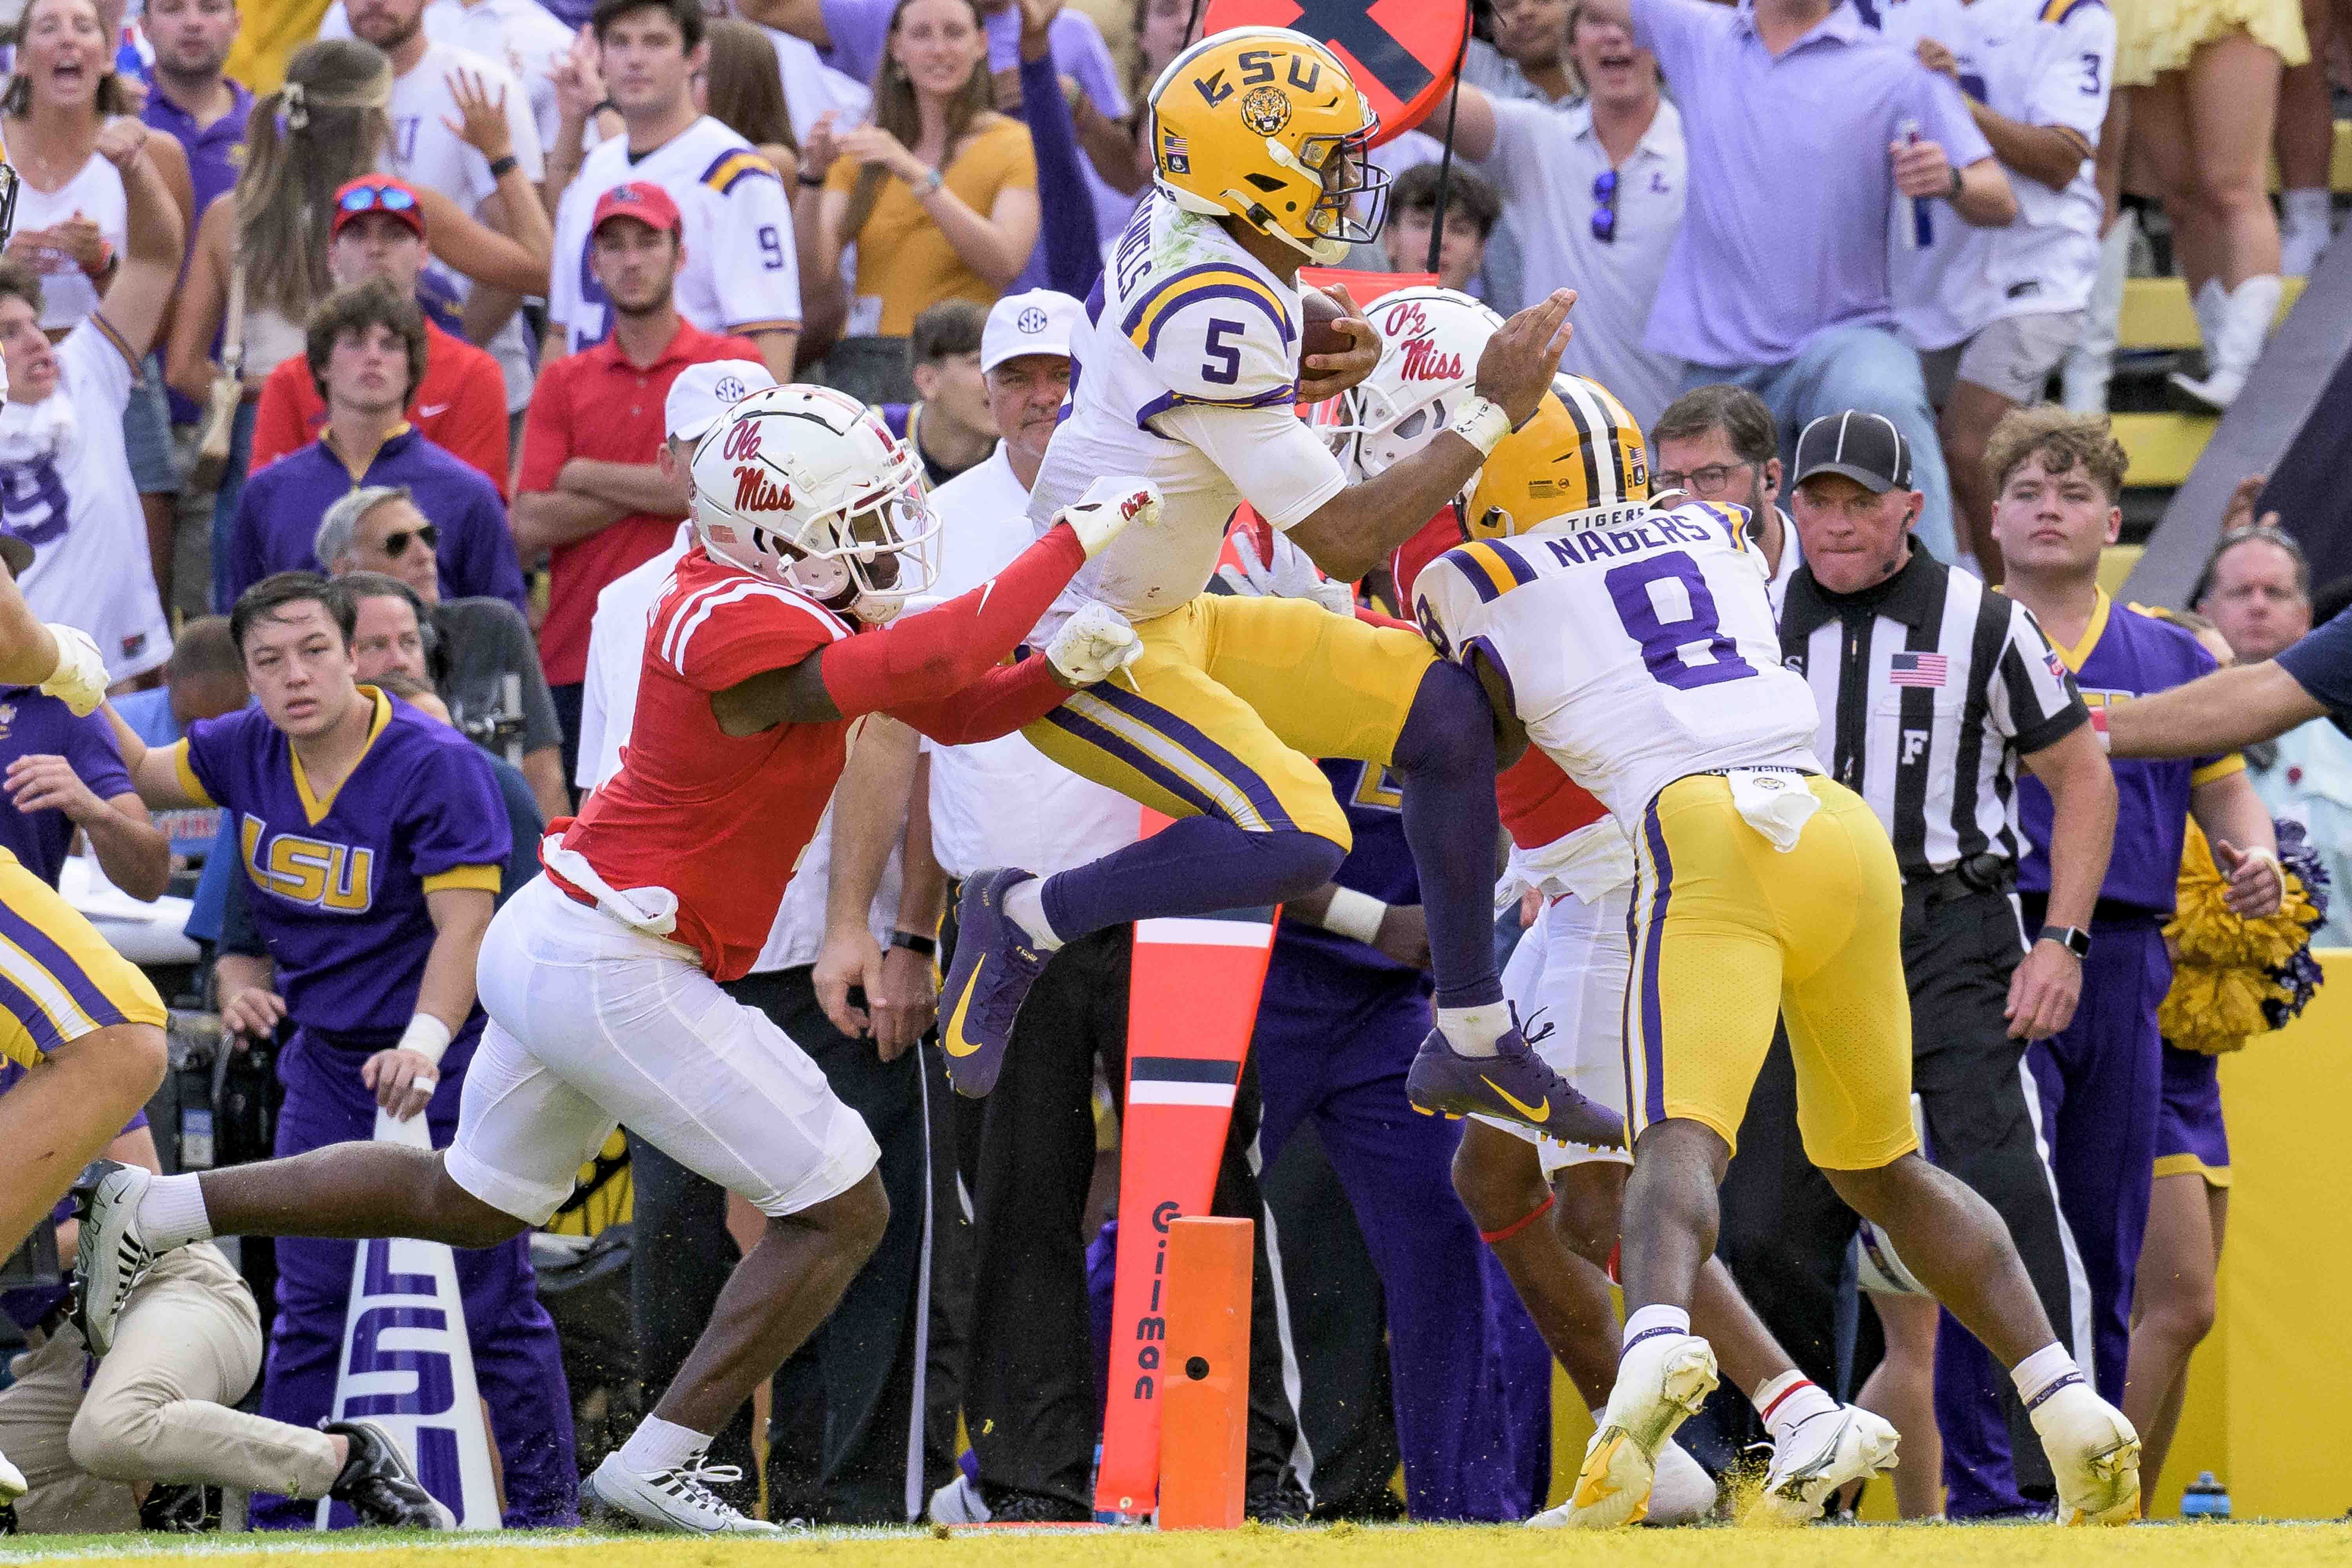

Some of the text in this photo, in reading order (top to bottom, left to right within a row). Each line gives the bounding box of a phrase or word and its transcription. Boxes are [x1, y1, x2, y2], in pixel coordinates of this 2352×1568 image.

[1193, 51, 1321, 108] LSU
[2081, 53, 2100, 95] 3
[1116, 192, 1156, 303] ANIELS
[1201, 318, 1244, 385] 5
[1401, 339, 1465, 381] Miss
[723, 419, 761, 461] Ole
[733, 466, 795, 512] Miss
[1567, 508, 1645, 531] TIGERS
[1604, 551, 1759, 691] 8
[1903, 730, 1929, 765] F
[241, 812, 375, 913] LSU
[1134, 1201, 1181, 1400] Gilman
